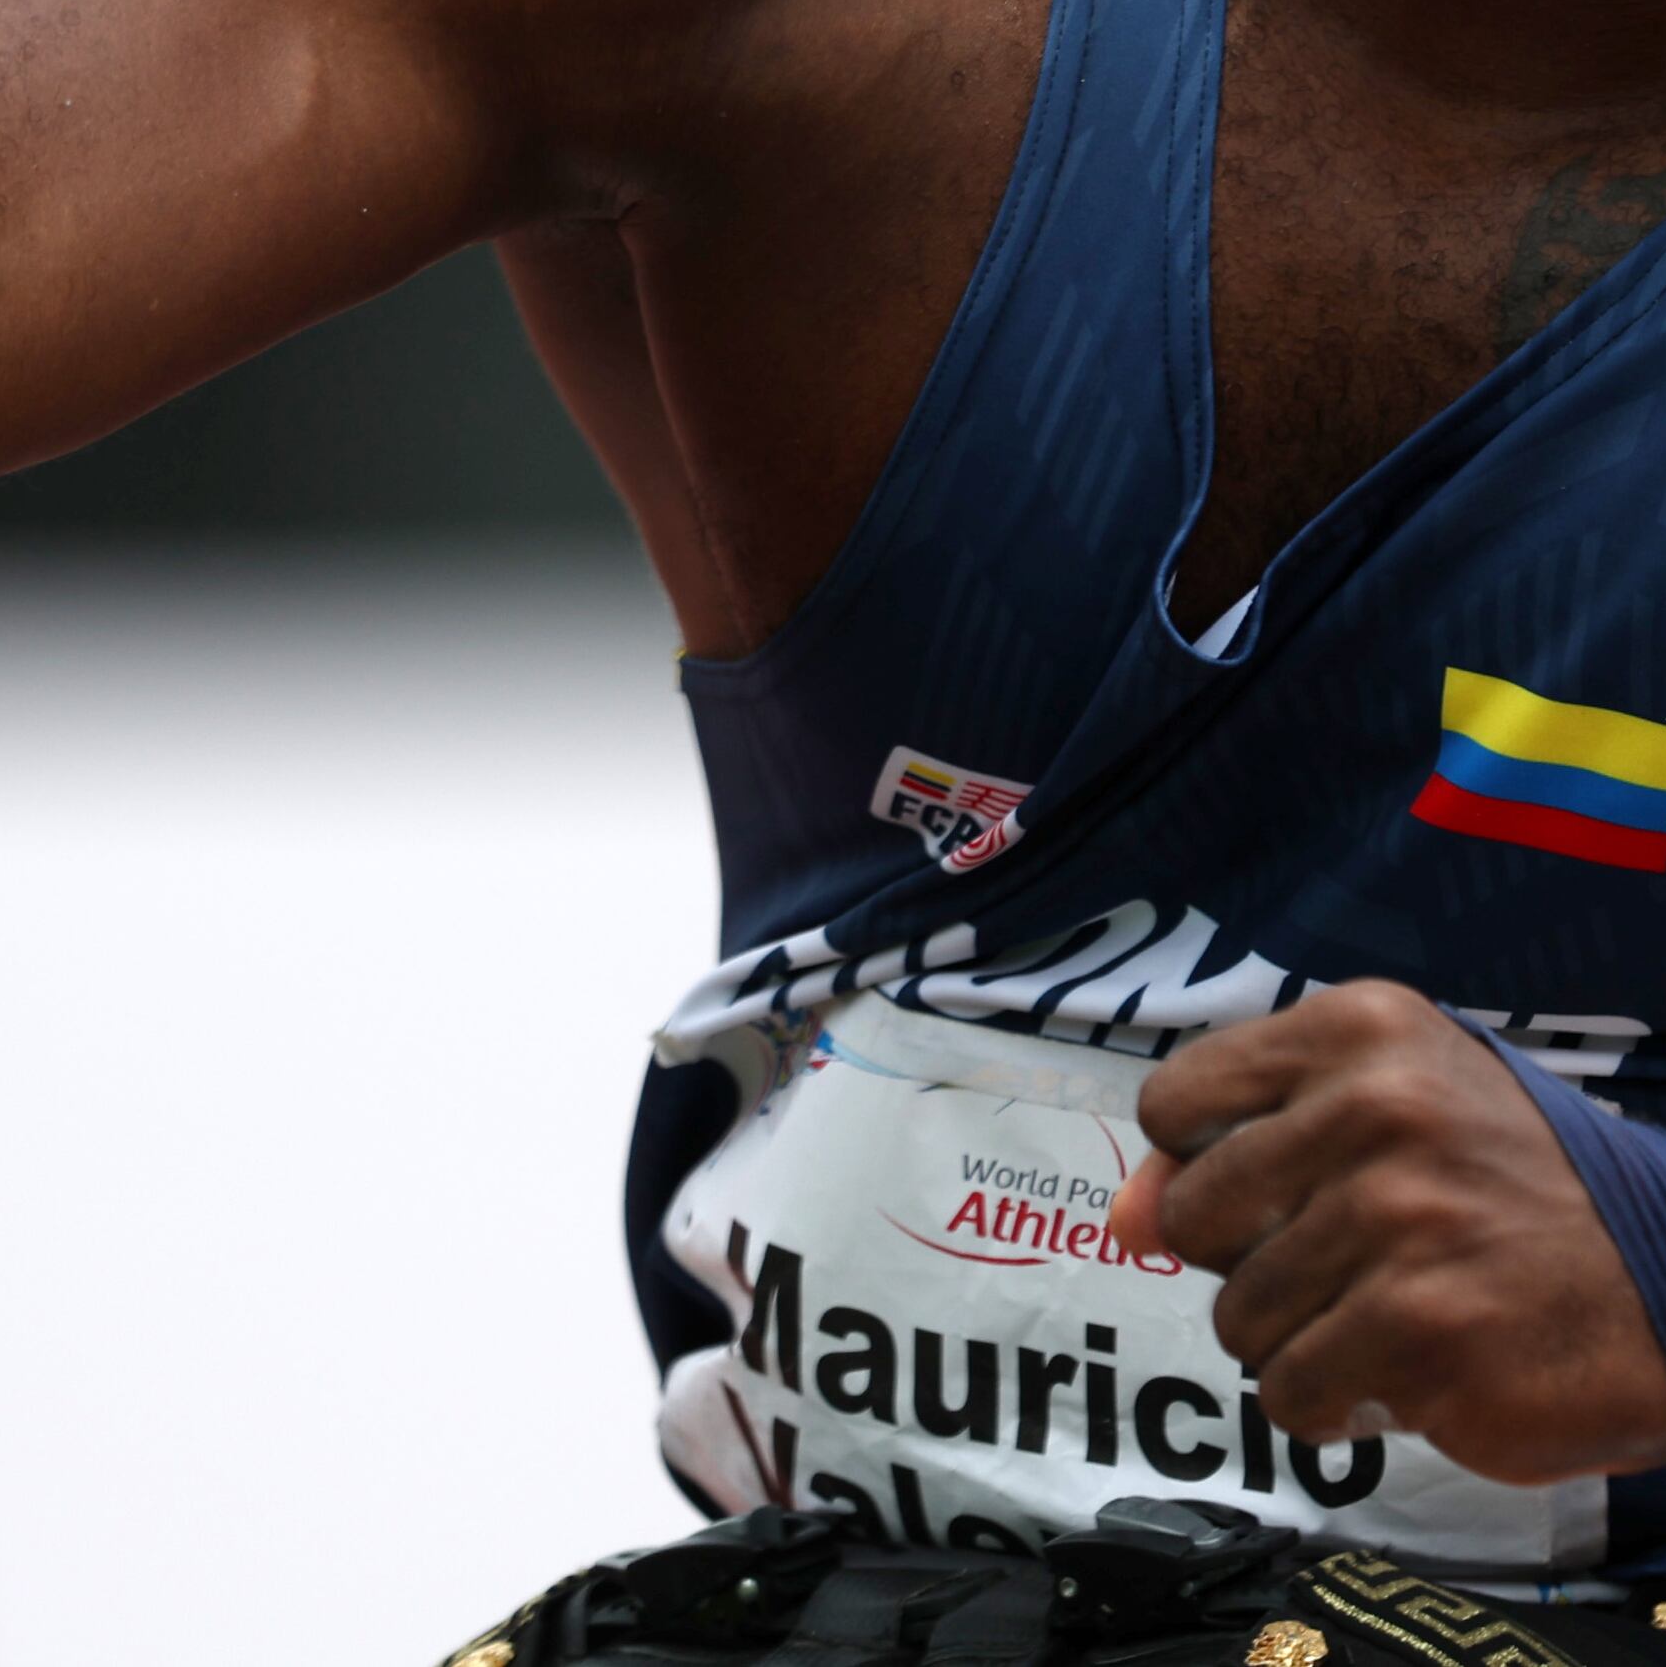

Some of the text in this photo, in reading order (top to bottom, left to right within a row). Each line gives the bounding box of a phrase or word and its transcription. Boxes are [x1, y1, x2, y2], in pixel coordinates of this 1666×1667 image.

[961, 1153, 1117, 1210] World Pa
[726, 1218, 1386, 1510] Mauricio
